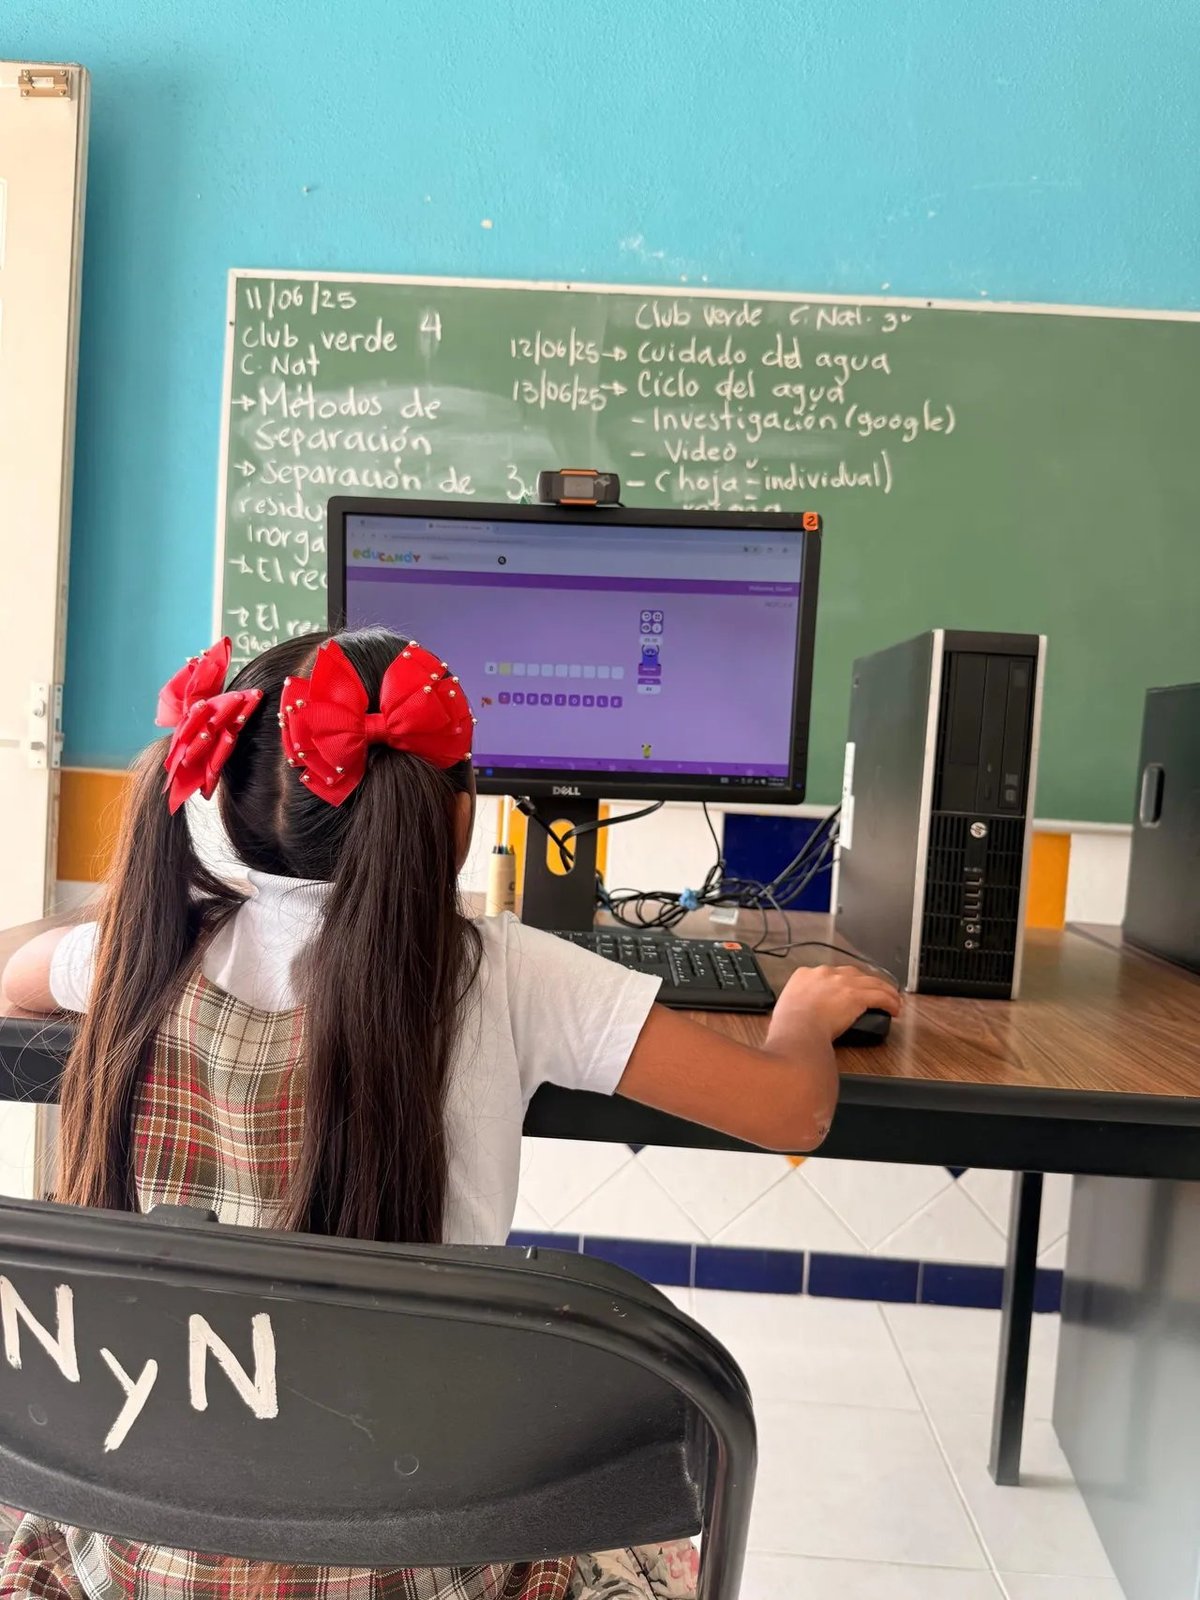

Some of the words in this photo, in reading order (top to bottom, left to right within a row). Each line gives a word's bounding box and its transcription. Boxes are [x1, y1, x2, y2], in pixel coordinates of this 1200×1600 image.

[246, 281, 357, 319] 11/06/25
[634, 301, 691, 329] Club
[241, 321, 299, 348] Club
[320, 317, 398, 352] verde
[419, 312, 442, 341] 4
[271, 344, 320, 377] Nat
[510, 327, 600, 366] 12/06/25
[815, 352, 891, 386] agua
[258, 381, 383, 420] Métodos
[400, 387, 442, 420] de
[513, 369, 608, 411] 13/06/25
[638, 367, 700, 398] Ciclo
[715, 367, 756, 400] del
[772, 382, 845, 413] agua
[846, 400, 956, 442] (google)
[255, 420, 432, 457] Separación
[664, 434, 738, 464] Video
[440, 466, 475, 495] de
[240, 492, 328, 522] residu
[806, 515, 817, 527] 2
[256, 556, 285, 584] El
[255, 603, 280, 632] El
[552, 785, 581, 796] DELL
